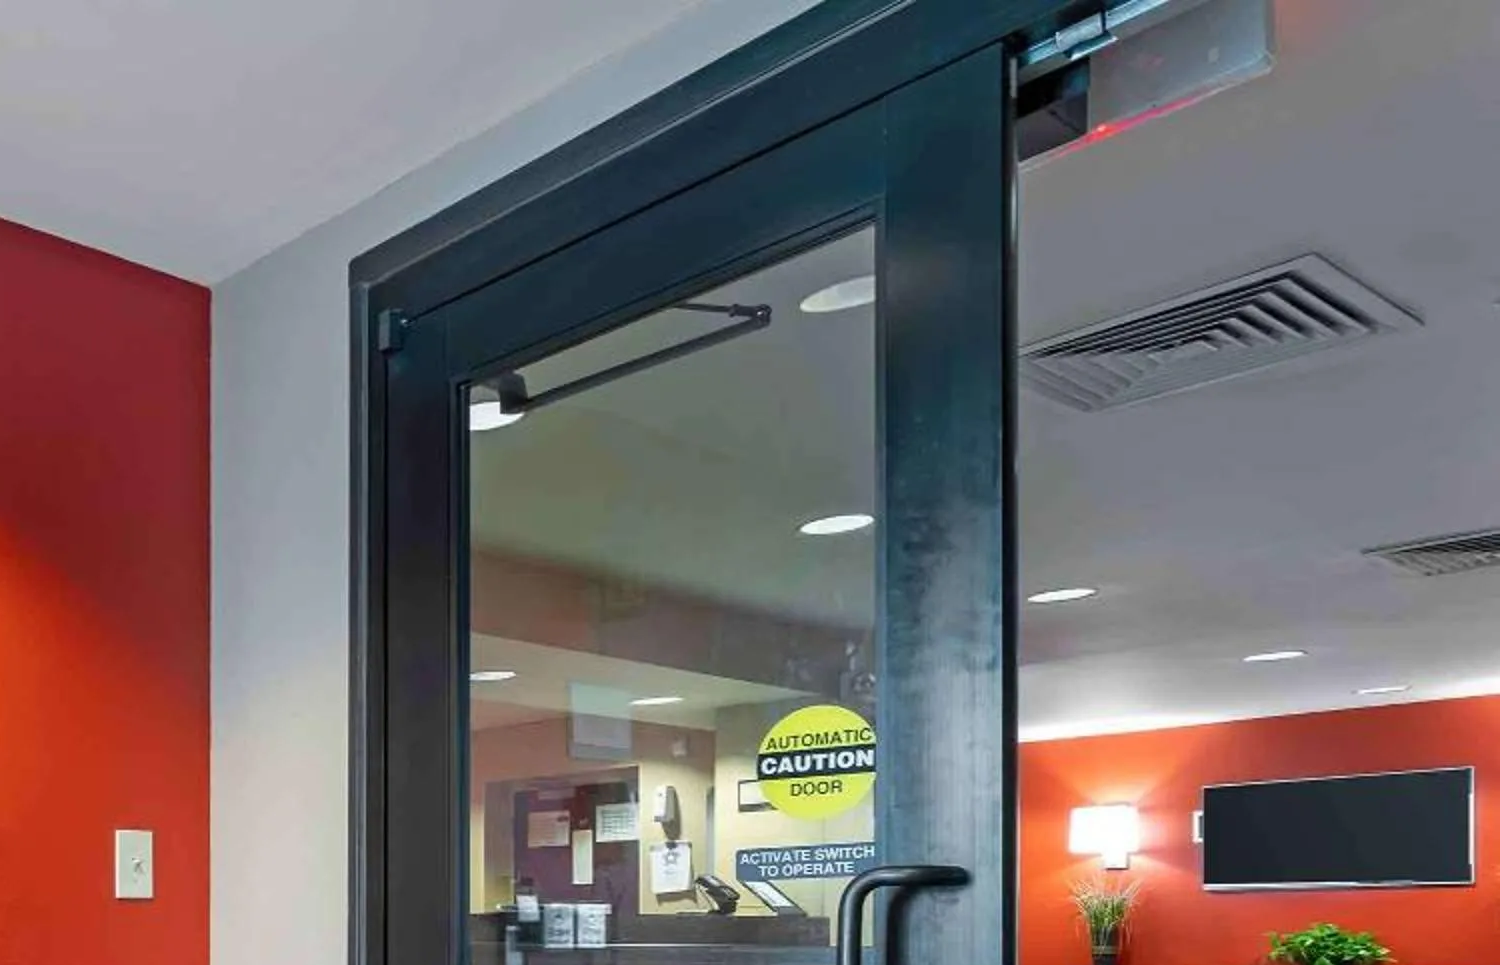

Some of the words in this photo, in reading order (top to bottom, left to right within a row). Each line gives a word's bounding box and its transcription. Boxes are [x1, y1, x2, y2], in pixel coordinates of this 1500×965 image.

[766, 727, 873, 750] AUTOMATIC
[760, 750, 874, 774] CAUTION
[790, 780, 843, 797] DOOR
[740, 848, 813, 865] ACTIVATE
[814, 845, 875, 861] SWITCH
[759, 865, 779, 877] TO
[782, 862, 854, 877] OPERATE
